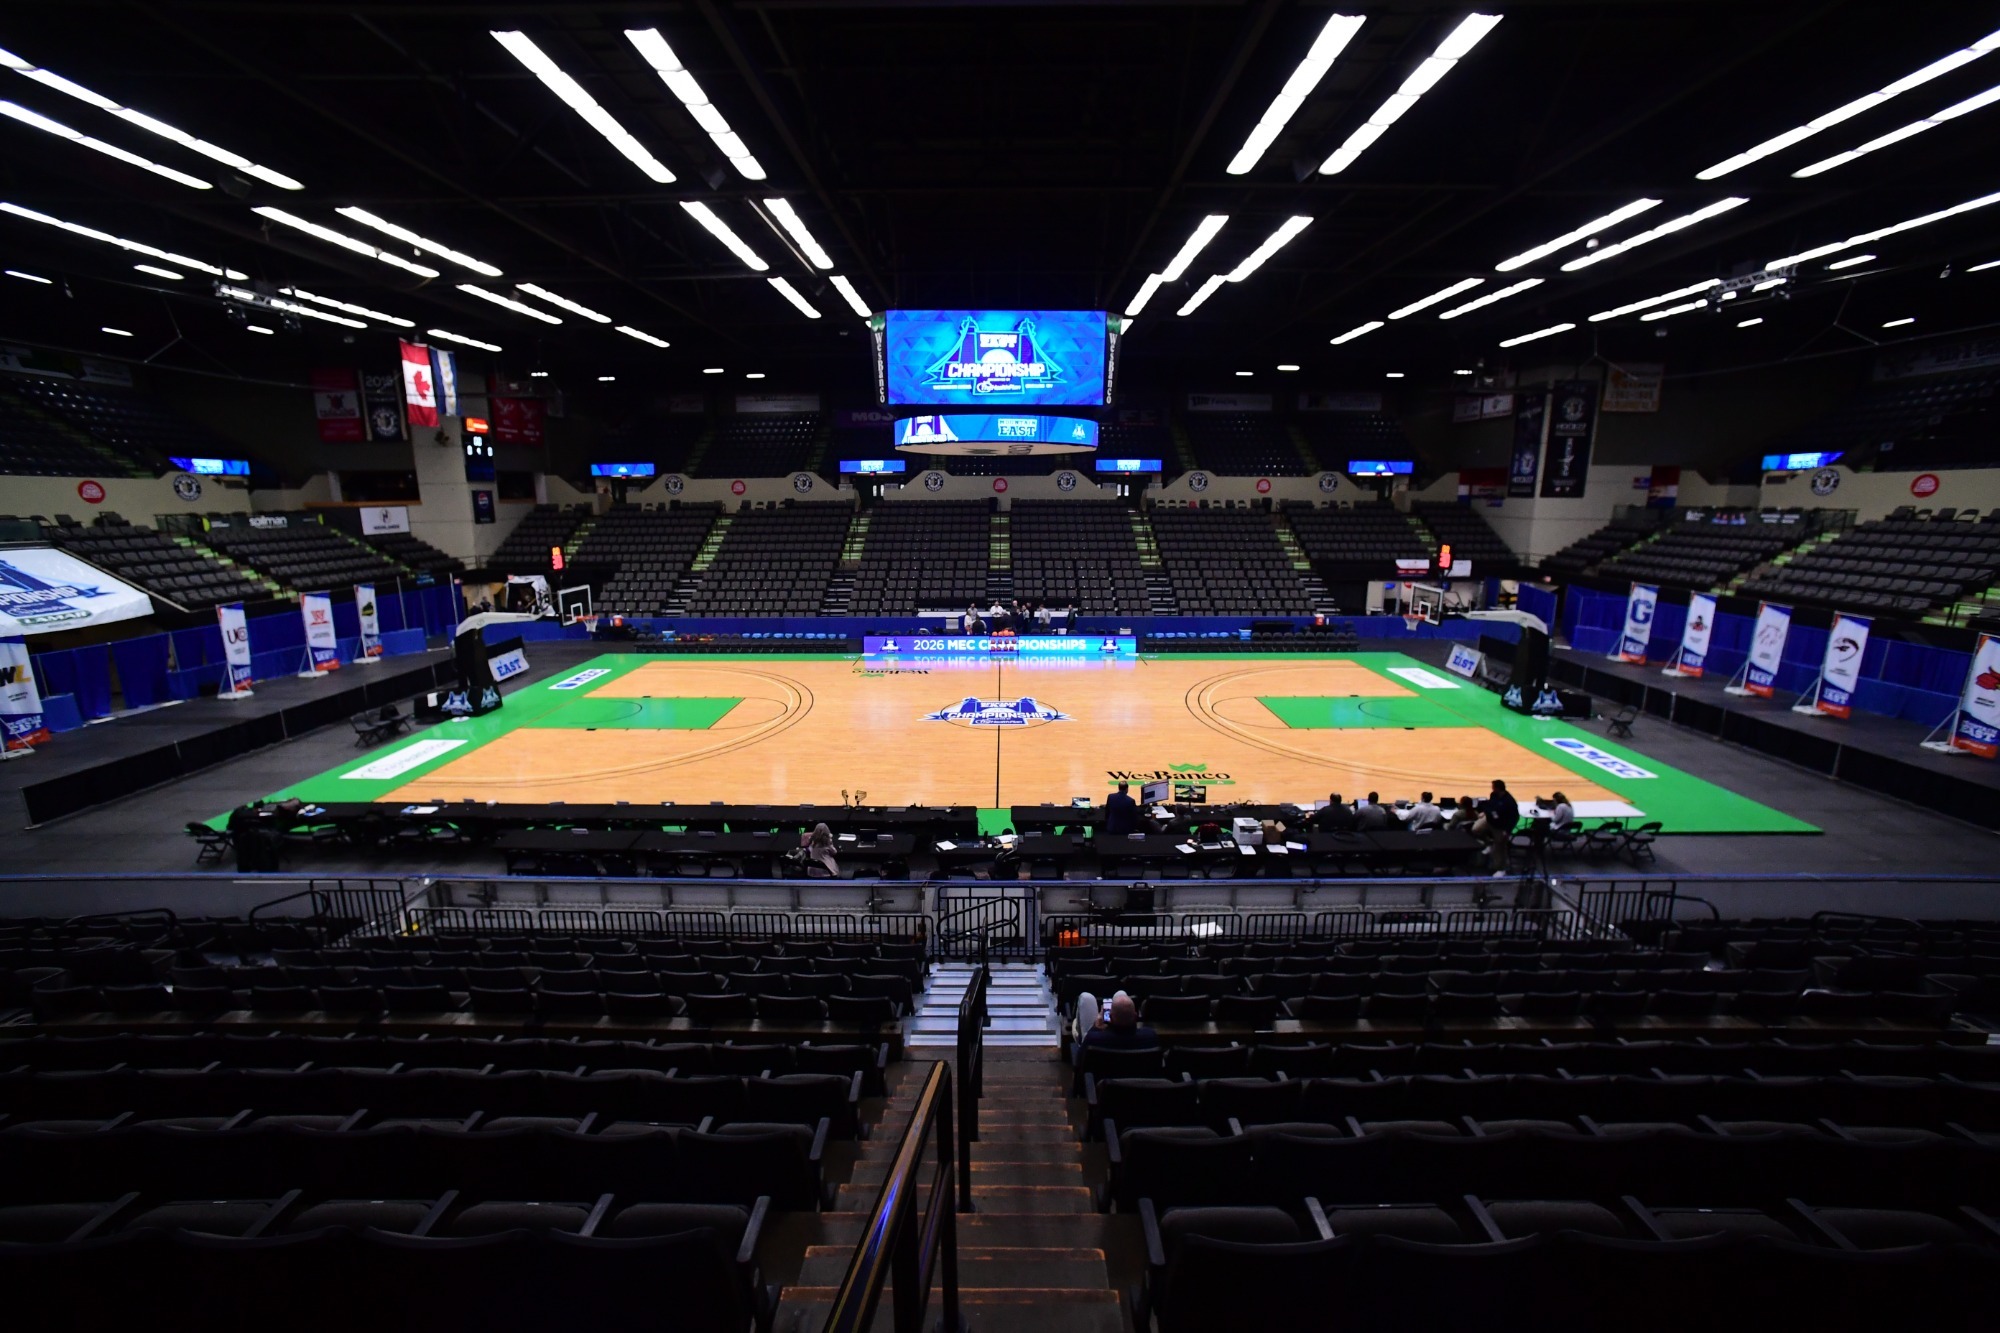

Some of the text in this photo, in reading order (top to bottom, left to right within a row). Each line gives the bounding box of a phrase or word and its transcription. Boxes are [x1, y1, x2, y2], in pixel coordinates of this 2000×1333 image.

[874, 332, 885, 404] WesBanco
[948, 362, 1046, 378] CHAMPIONSHIP
[1106, 333, 1118, 404] WesBanco
[1000, 426, 1036, 436] EAST
[24, 610, 88, 624] LAMAR
[913, 639, 945, 651] 2026
[948, 639, 976, 651] MEC
[496, 658, 522, 677] EAST
[947, 711, 1049, 719] CHAMPIONSHIP
[1106, 770, 1231, 780] WesBanco
